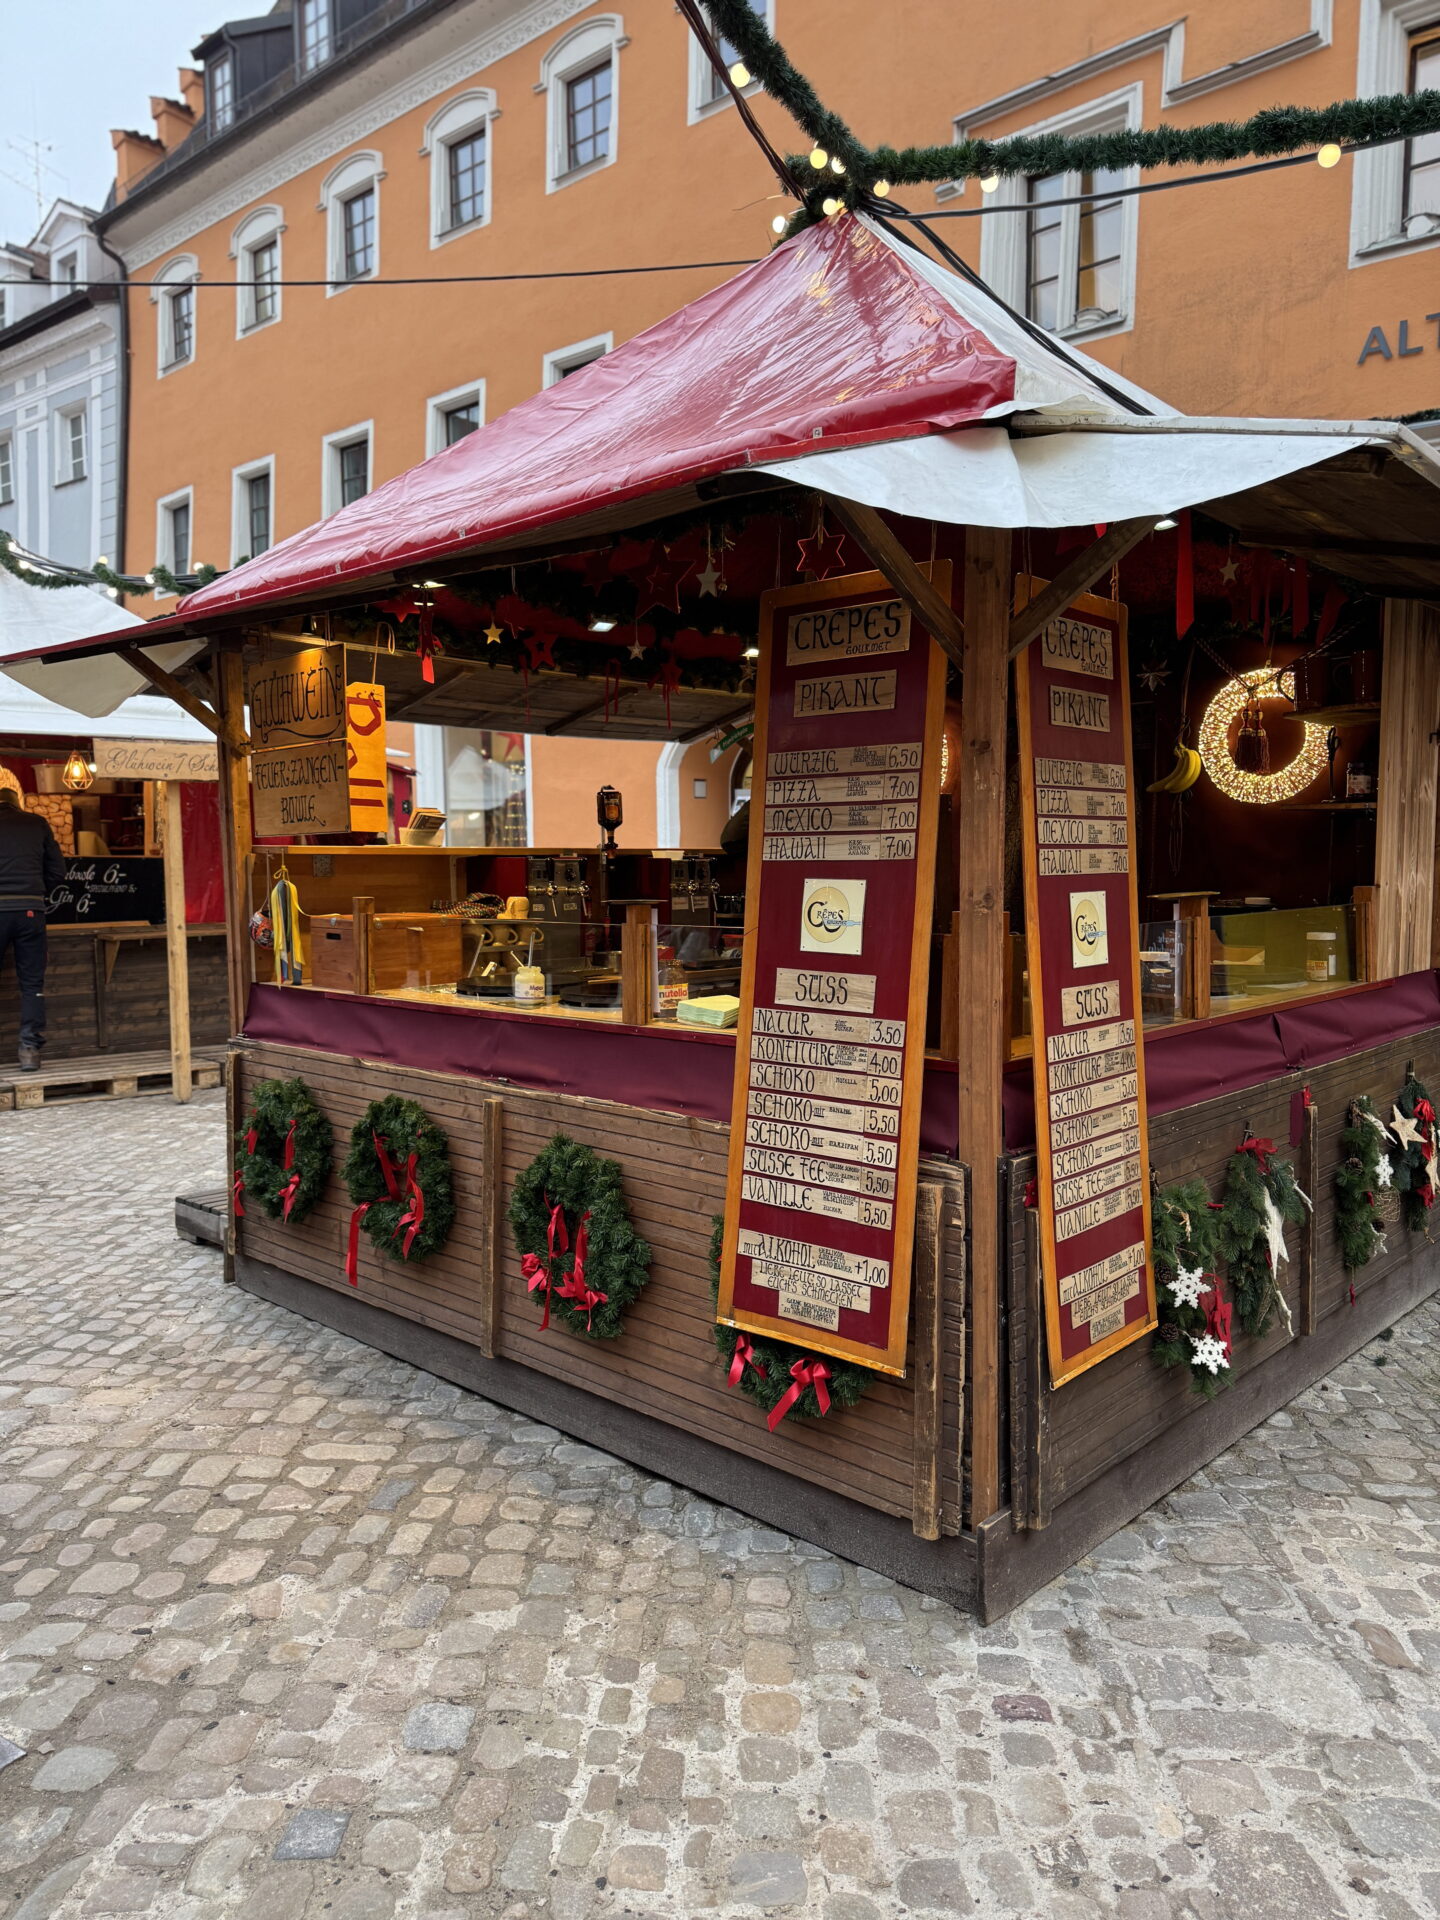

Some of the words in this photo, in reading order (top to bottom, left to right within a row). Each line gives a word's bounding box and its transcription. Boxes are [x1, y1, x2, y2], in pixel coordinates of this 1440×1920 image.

[800, 676, 886, 711] PIKANT
[1053, 690, 1106, 727] PIKANT
[774, 750, 839, 775] WÜRZIG
[888, 748, 918, 769] 6,50
[772, 779, 821, 802] PIZZA
[889, 775, 915, 798] 7,00
[1040, 789, 1072, 813] PIZZA
[772, 807, 833, 832] MEXICO
[888, 807, 915, 829] 7,00
[1043, 820, 1084, 843] MEXICO
[769, 836, 827, 860] HAWAII
[885, 836, 911, 858] 7,00
[1042, 850, 1082, 874] HAWAII
[795, 973, 848, 1005] SÜSS
[758, 1009, 813, 1036] NATUR
[873, 1020, 901, 1045] 3,50
[757, 1037, 836, 1067] KONFITÜRE
[870, 1051, 897, 1075] 4,00
[1052, 1030, 1090, 1060] NATUR
[756, 1064, 815, 1093] SCHOKO
[871, 1079, 898, 1103] 5,00
[754, 1093, 813, 1121] SCHOKO
[869, 1110, 896, 1134] 5,50
[1055, 1087, 1092, 1117] SCHOKO
[750, 1121, 810, 1151] SCHOKO
[866, 1142, 893, 1166] 5,50
[1055, 1115, 1093, 1146] SCHOKO
[749, 1149, 795, 1177] SÜSSE
[800, 1158, 827, 1184] FEE
[865, 1171, 889, 1194] 5,50
[1056, 1144, 1094, 1177] SCHOKO
[1086, 1170, 1104, 1196] FEE
[748, 1176, 813, 1210] VANILLE
[863, 1201, 887, 1226] 5,50
[1059, 1202, 1101, 1238] VANILLE
[758, 1234, 816, 1269] ALKOHOL
[760, 1261, 785, 1276] LIEBE
[816, 1275, 827, 1288] SO
[830, 1278, 863, 1298] LASSET
[802, 1284, 853, 1308] SCHMECKEN
[1072, 1262, 1108, 1298] ALKOHOL
